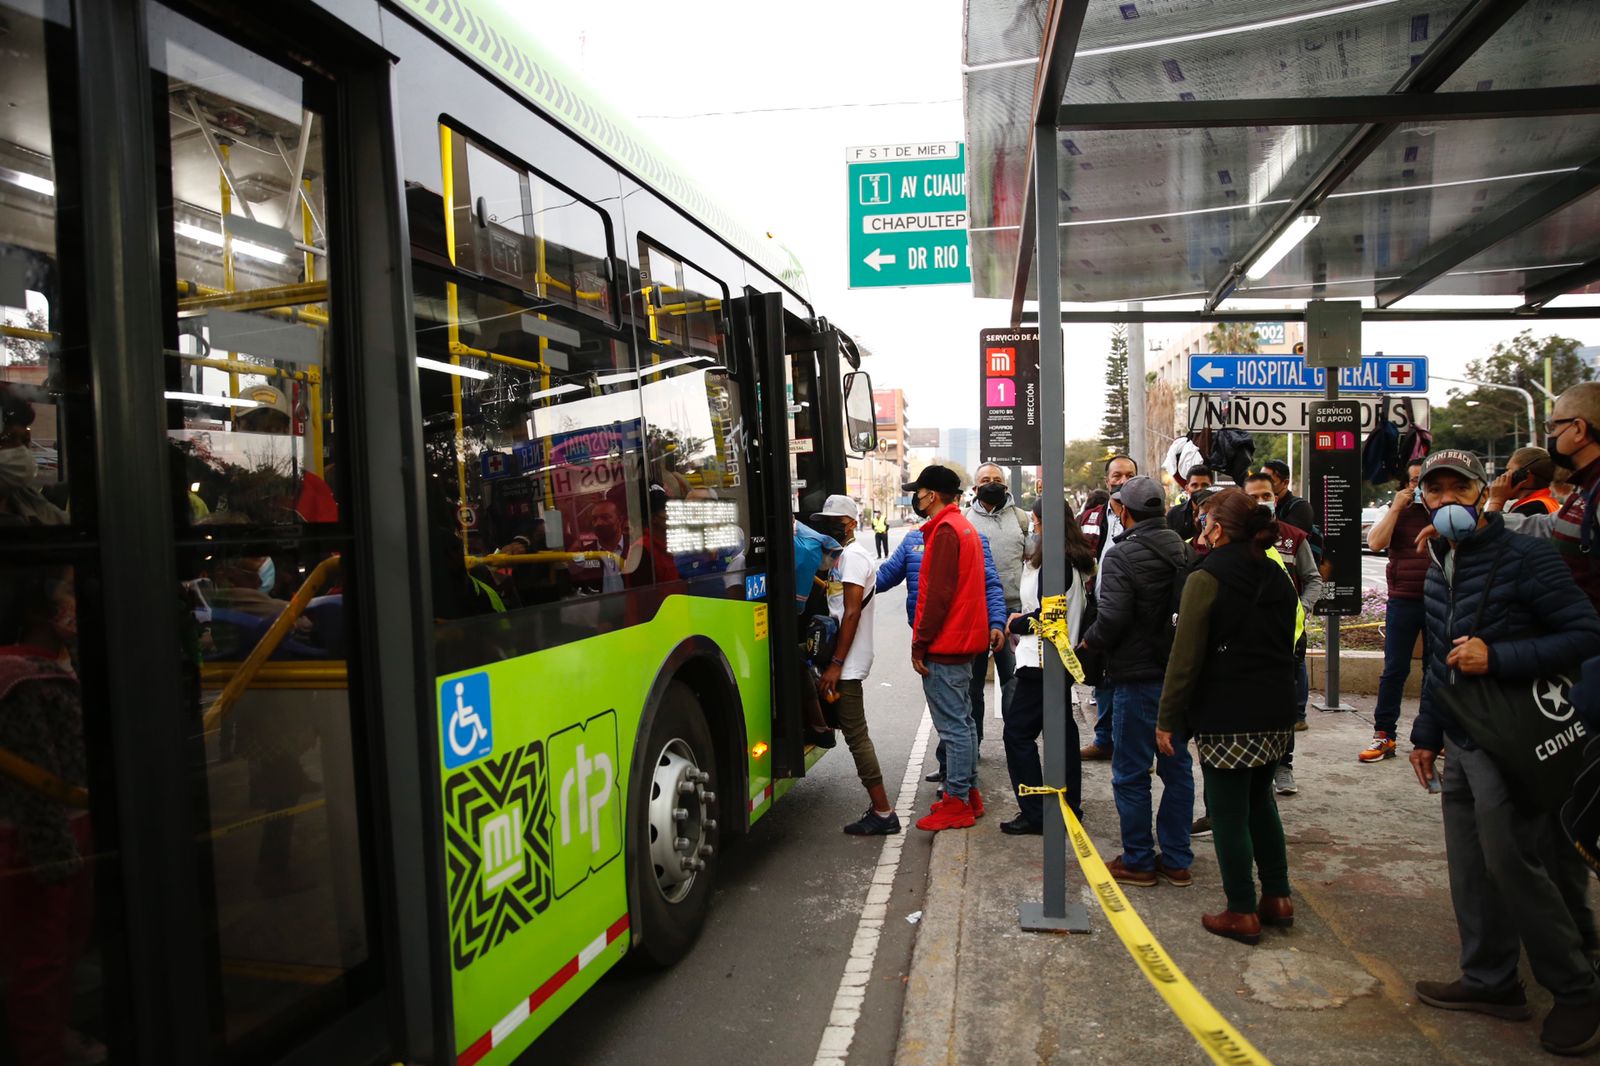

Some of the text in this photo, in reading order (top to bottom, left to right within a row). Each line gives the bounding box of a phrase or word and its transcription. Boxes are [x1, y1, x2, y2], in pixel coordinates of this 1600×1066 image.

[856, 145, 946, 158] F S T DE MIER
[901, 176, 917, 198] AV
[872, 214, 966, 230] CHAPULTEP
[908, 247, 927, 270] DR
[935, 245, 958, 268] RIO
[1237, 361, 1306, 386] HOSPITAL
[998, 383, 1004, 402] 1
[1026, 383, 1034, 425] DIRECCIÓN
[1342, 435, 1346, 446] 1
[1426, 452, 1472, 468] MIAMI BEACH
